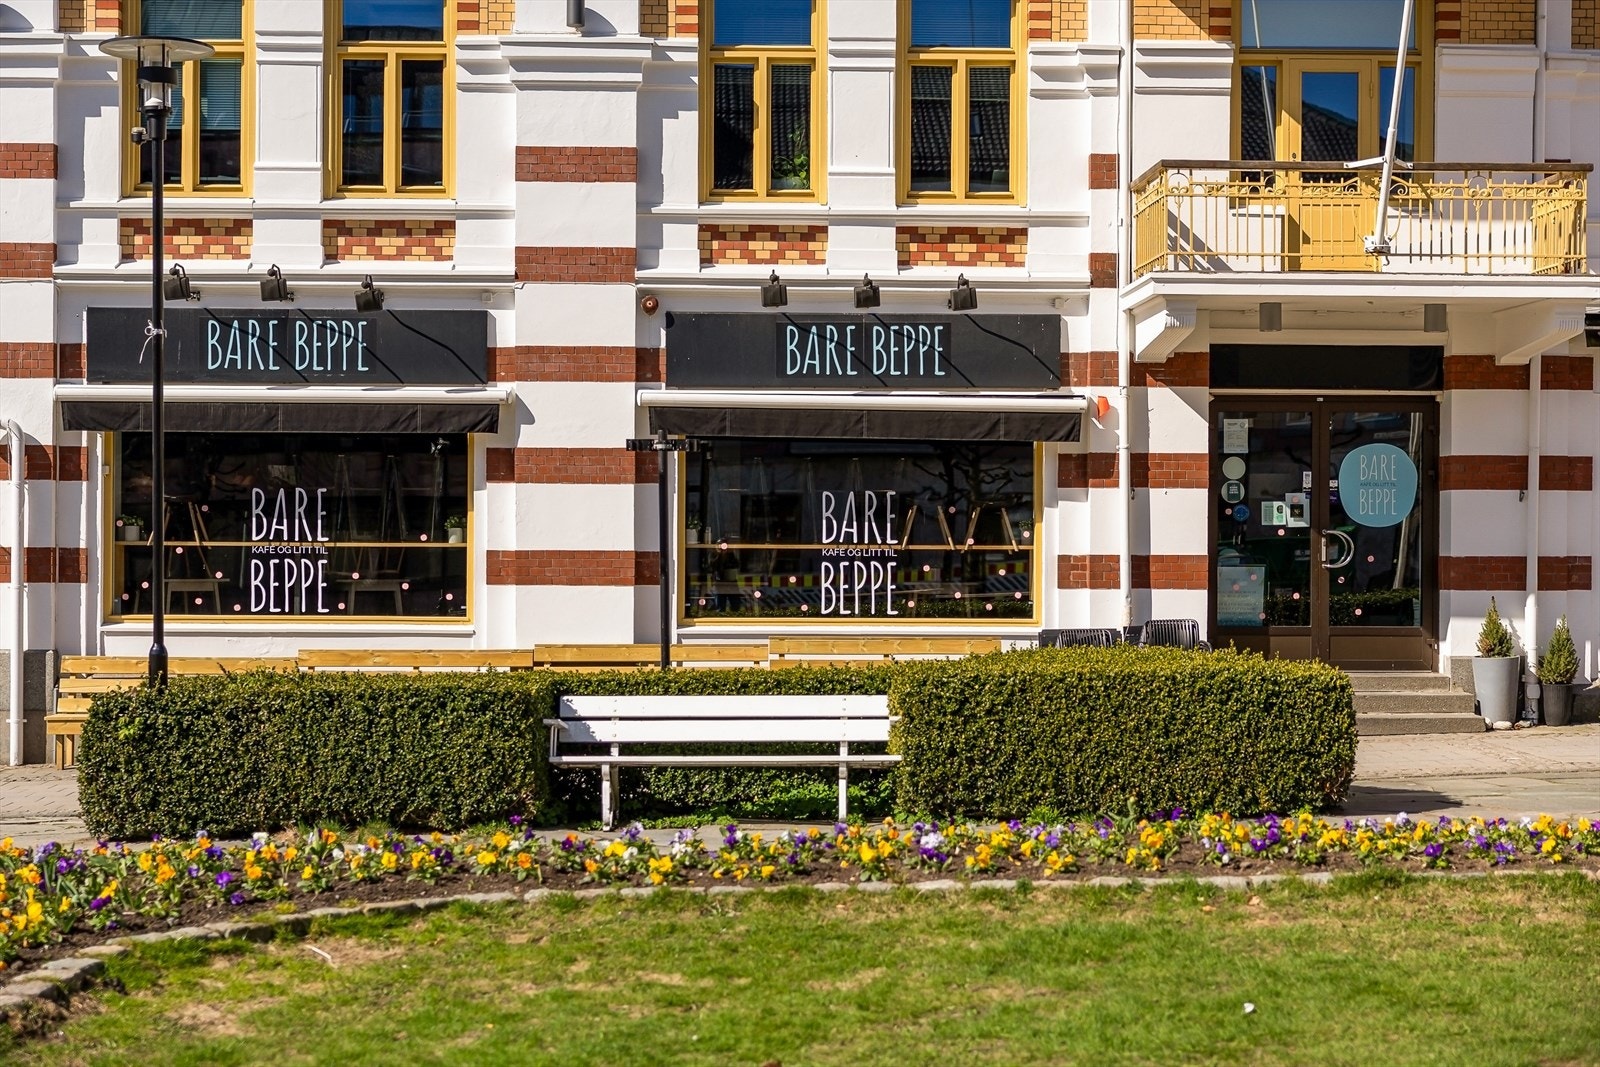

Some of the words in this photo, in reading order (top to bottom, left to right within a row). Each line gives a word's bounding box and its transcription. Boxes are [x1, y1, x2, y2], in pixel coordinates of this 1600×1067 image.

[207, 319, 281, 371] BARE
[295, 320, 369, 371] BEPPE
[786, 324, 858, 375] BARE
[872, 325, 946, 375] BEPPE
[1360, 454, 1397, 481] BARE
[251, 487, 330, 542] BARE
[821, 490, 899, 545] BARE
[1359, 488, 1398, 515] BEPPE
[277, 545, 292, 554] OG
[293, 545, 313, 555] LITT
[313, 545, 329, 555] TIL
[846, 548, 861, 557] OG
[863, 548, 883, 557] LITT
[883, 548, 898, 557] TIL
[250, 558, 330, 613] BEPPE
[820, 560, 899, 615] BEPPE
